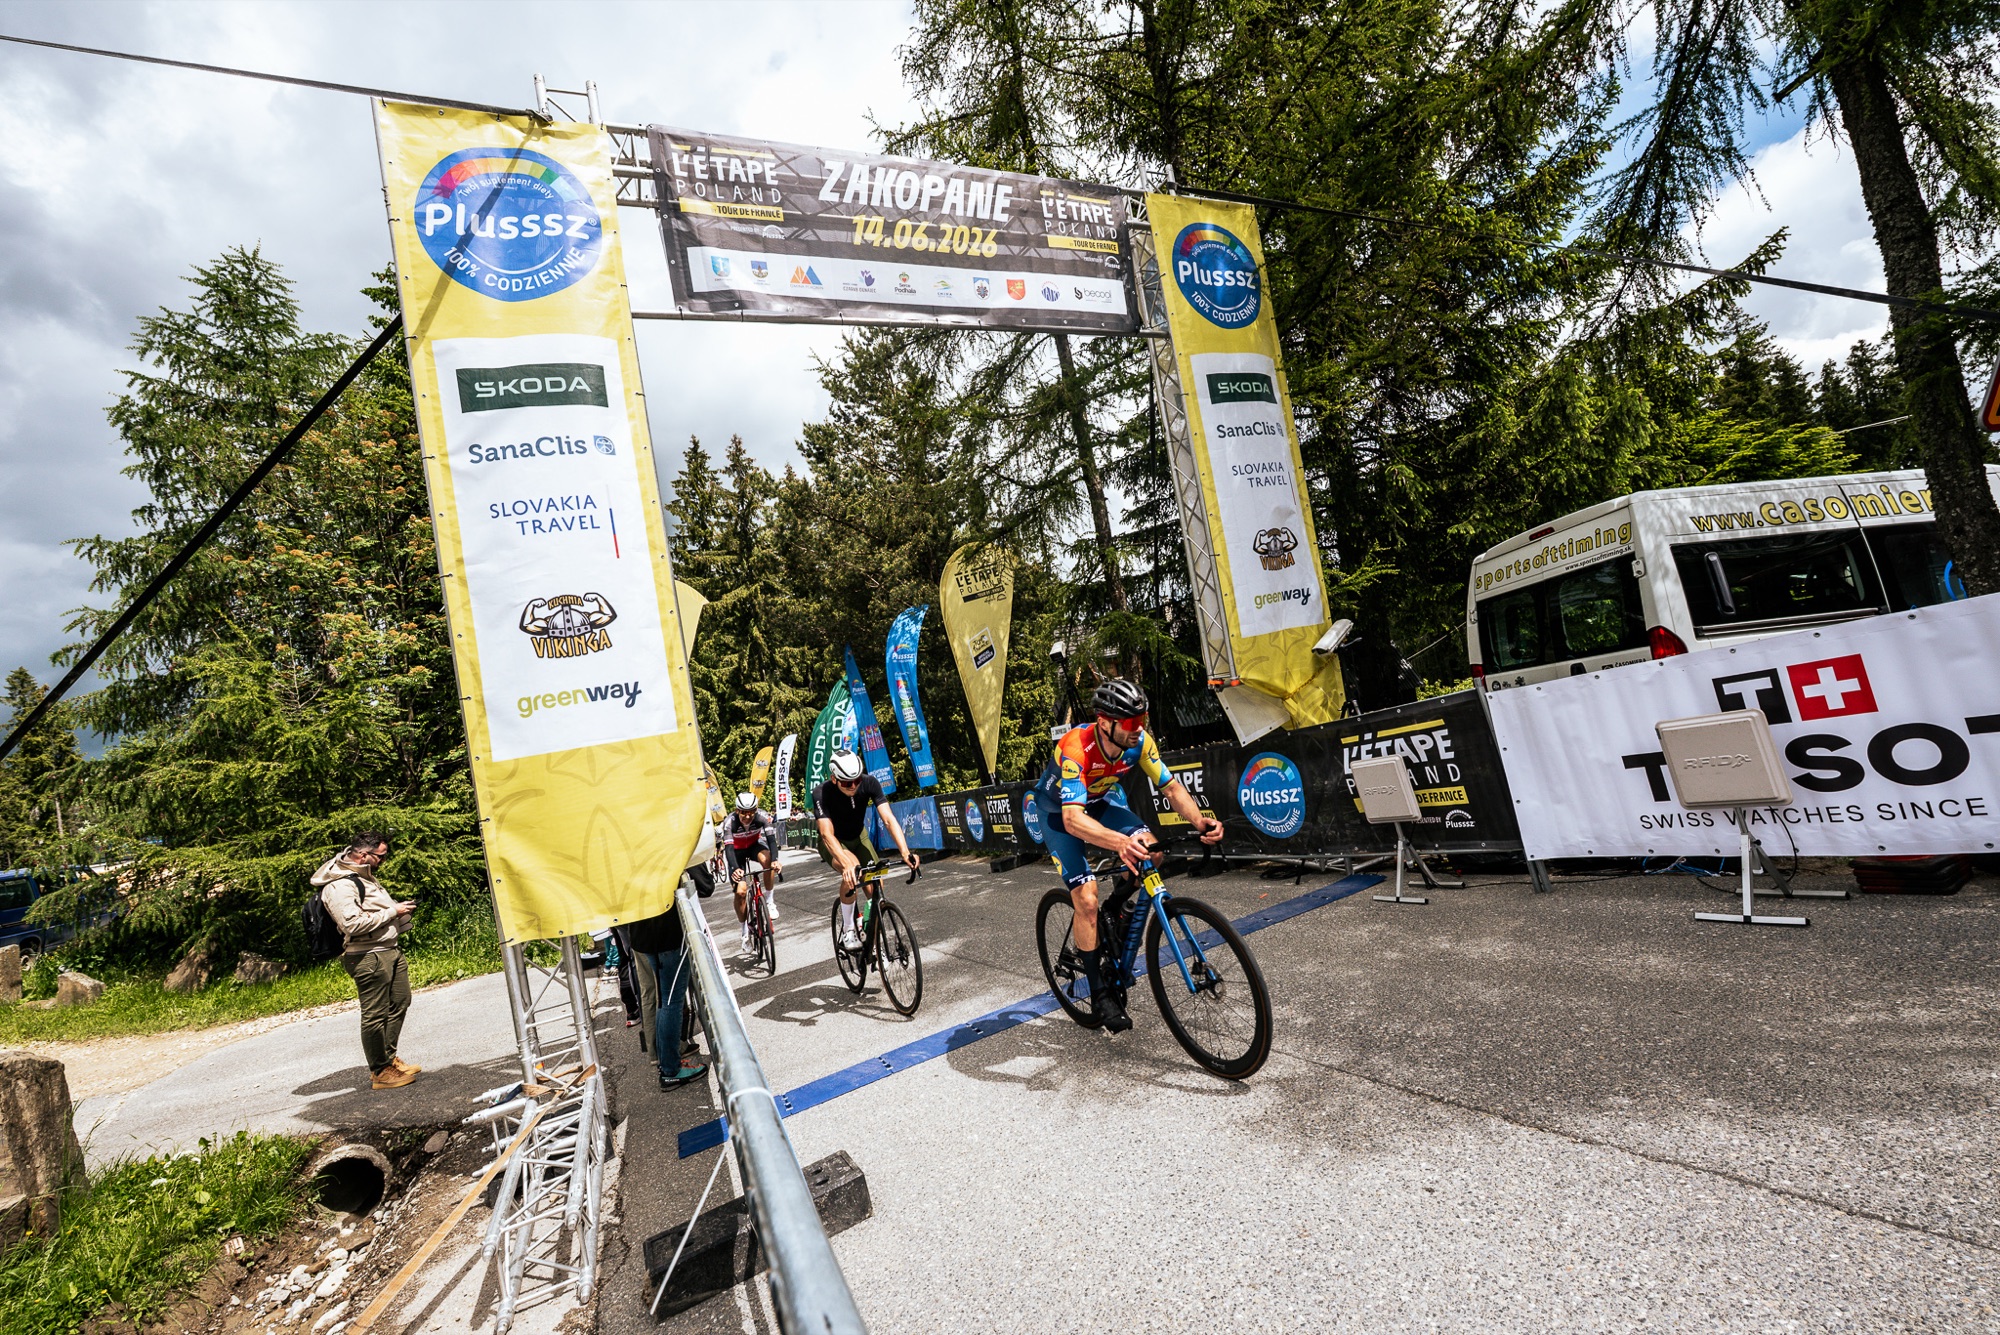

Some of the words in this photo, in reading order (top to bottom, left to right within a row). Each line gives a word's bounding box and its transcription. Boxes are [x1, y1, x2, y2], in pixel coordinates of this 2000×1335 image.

[479, 175, 531, 188] suplement
[532, 182, 555, 200] diety
[676, 178, 782, 203] POLAND
[818, 160, 1013, 223] ZAKOPANE
[425, 202, 590, 240] Plusssz
[716, 205, 738, 215] TOUR
[740, 207, 750, 216] DE
[751, 208, 781, 218] FRANCE
[852, 214, 998, 258] 14.06.2026
[1044, 220, 1117, 239] POLAND
[1073, 240, 1088, 248] TOUR
[1089, 241, 1096, 249] DE
[1097, 242, 1117, 251] FRANCE
[443, 246, 478, 278] 100%
[484, 246, 585, 292] CODZIENNIE
[1178, 260, 1256, 290] Plusssz
[1191, 291, 1211, 313] 100%
[1212, 294, 1257, 322] CODZIENNIE
[1216, 421, 1276, 438] SanaClis
[468, 435, 588, 464] SanaClis
[1231, 461, 1285, 476] SLOVAKIA
[1247, 475, 1288, 488] TRAVEL
[489, 494, 597, 519] SLOVAKIA
[516, 514, 600, 536] TRAVEL
[1475, 521, 1632, 591] sportsofttiming
[547, 594, 584, 610] KUCHNIA
[1254, 587, 1311, 609] greenway
[530, 628, 612, 658] VIKINGA
[517, 681, 642, 718] greenway
[1621, 714, 2000, 802] TSO
[1683, 755, 1733, 770] RFID
[778, 750, 788, 792] TISSOT
[1345, 763, 1460, 795] PAND
[1153, 795, 1210, 811] POND
[1241, 787, 1300, 807] Plusssz
[1416, 794, 1429, 804] DE
[1429, 790, 1465, 803] FRANCE
[1023, 811, 1039, 823] Pluss
[1250, 811, 1265, 827] 100%
[1266, 807, 1301, 833] CODZIENNIE
[1445, 821, 1475, 829] Plusssz
[1640, 811, 1715, 830] SWISS
[1723, 804, 1865, 826] WATCHES
[1876, 797, 1988, 821] SINCE
